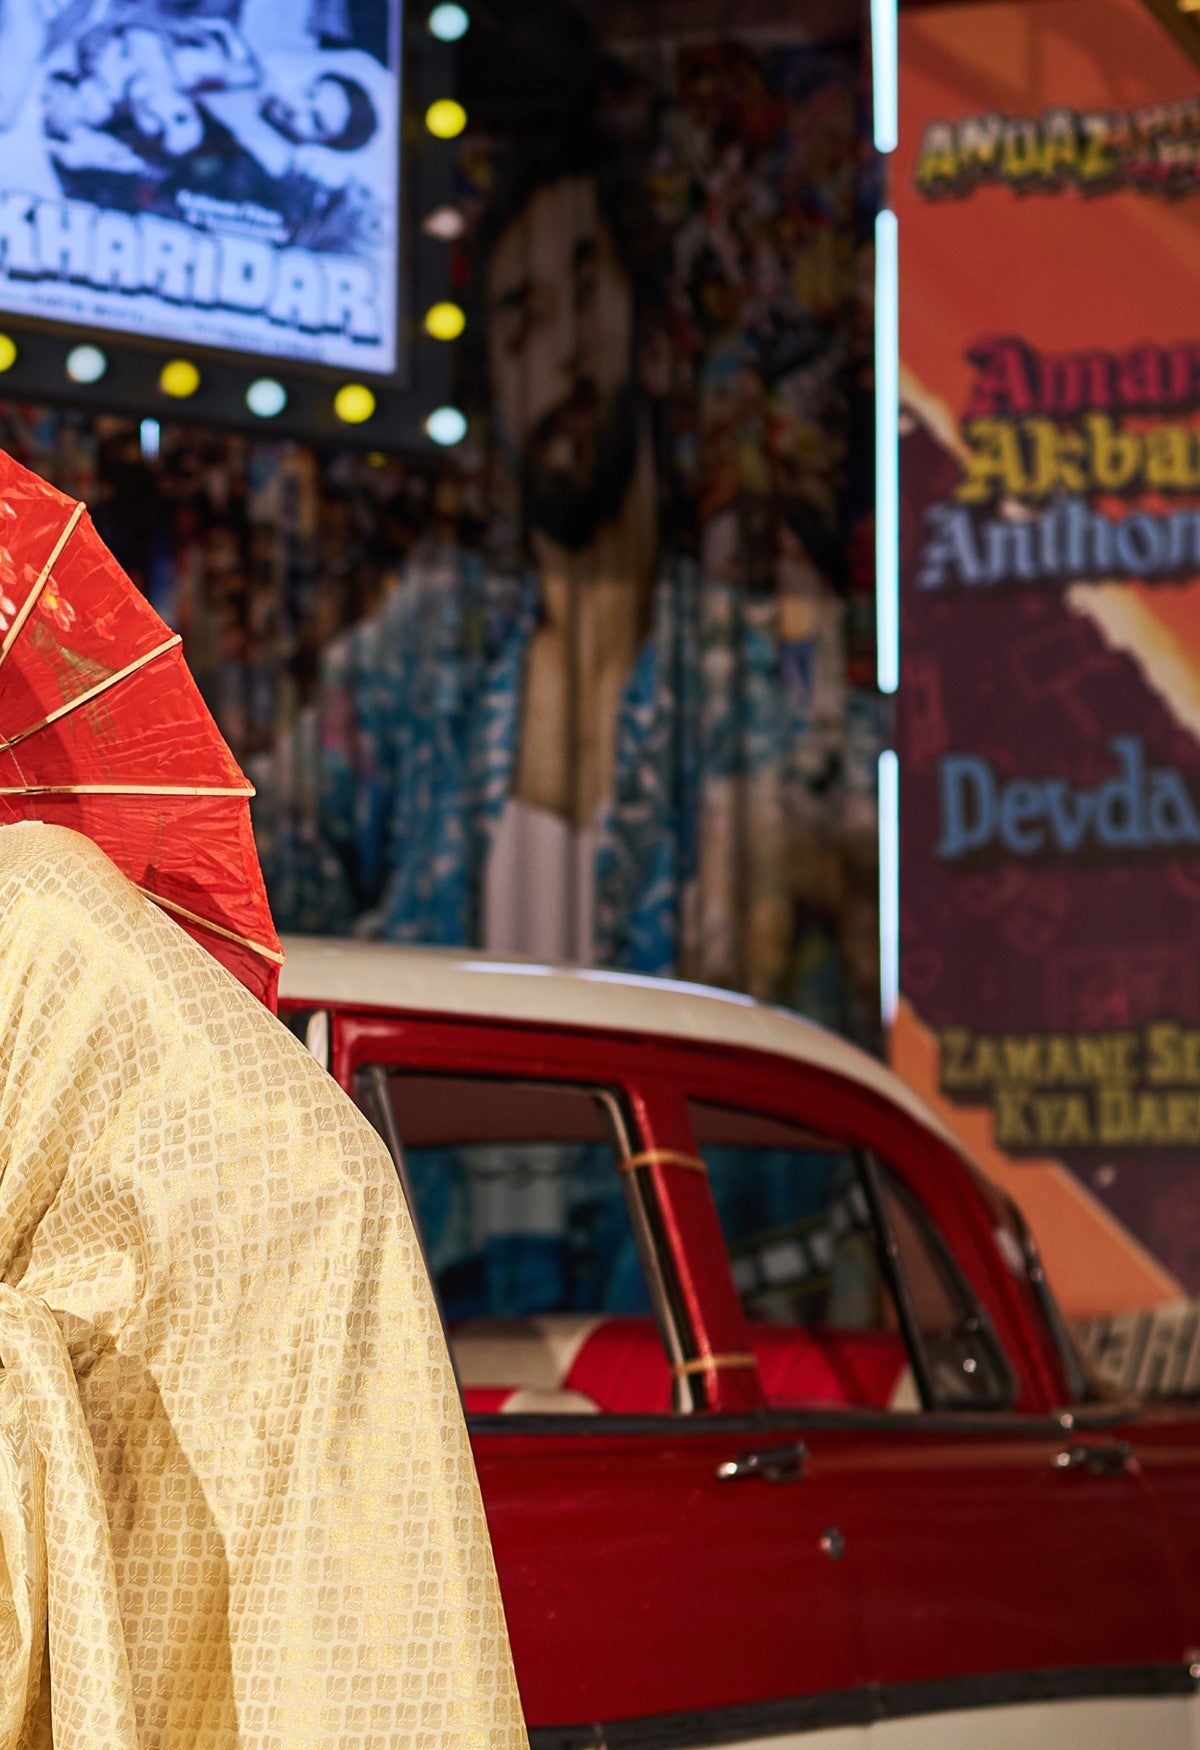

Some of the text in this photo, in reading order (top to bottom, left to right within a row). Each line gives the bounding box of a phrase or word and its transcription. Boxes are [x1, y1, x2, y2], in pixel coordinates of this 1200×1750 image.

[915, 108, 1118, 193] ANDAZ
[955, 411, 1200, 502] Akba
[942, 1028, 1138, 1085] ZAMANE
[997, 1088, 1091, 1145] KYA
